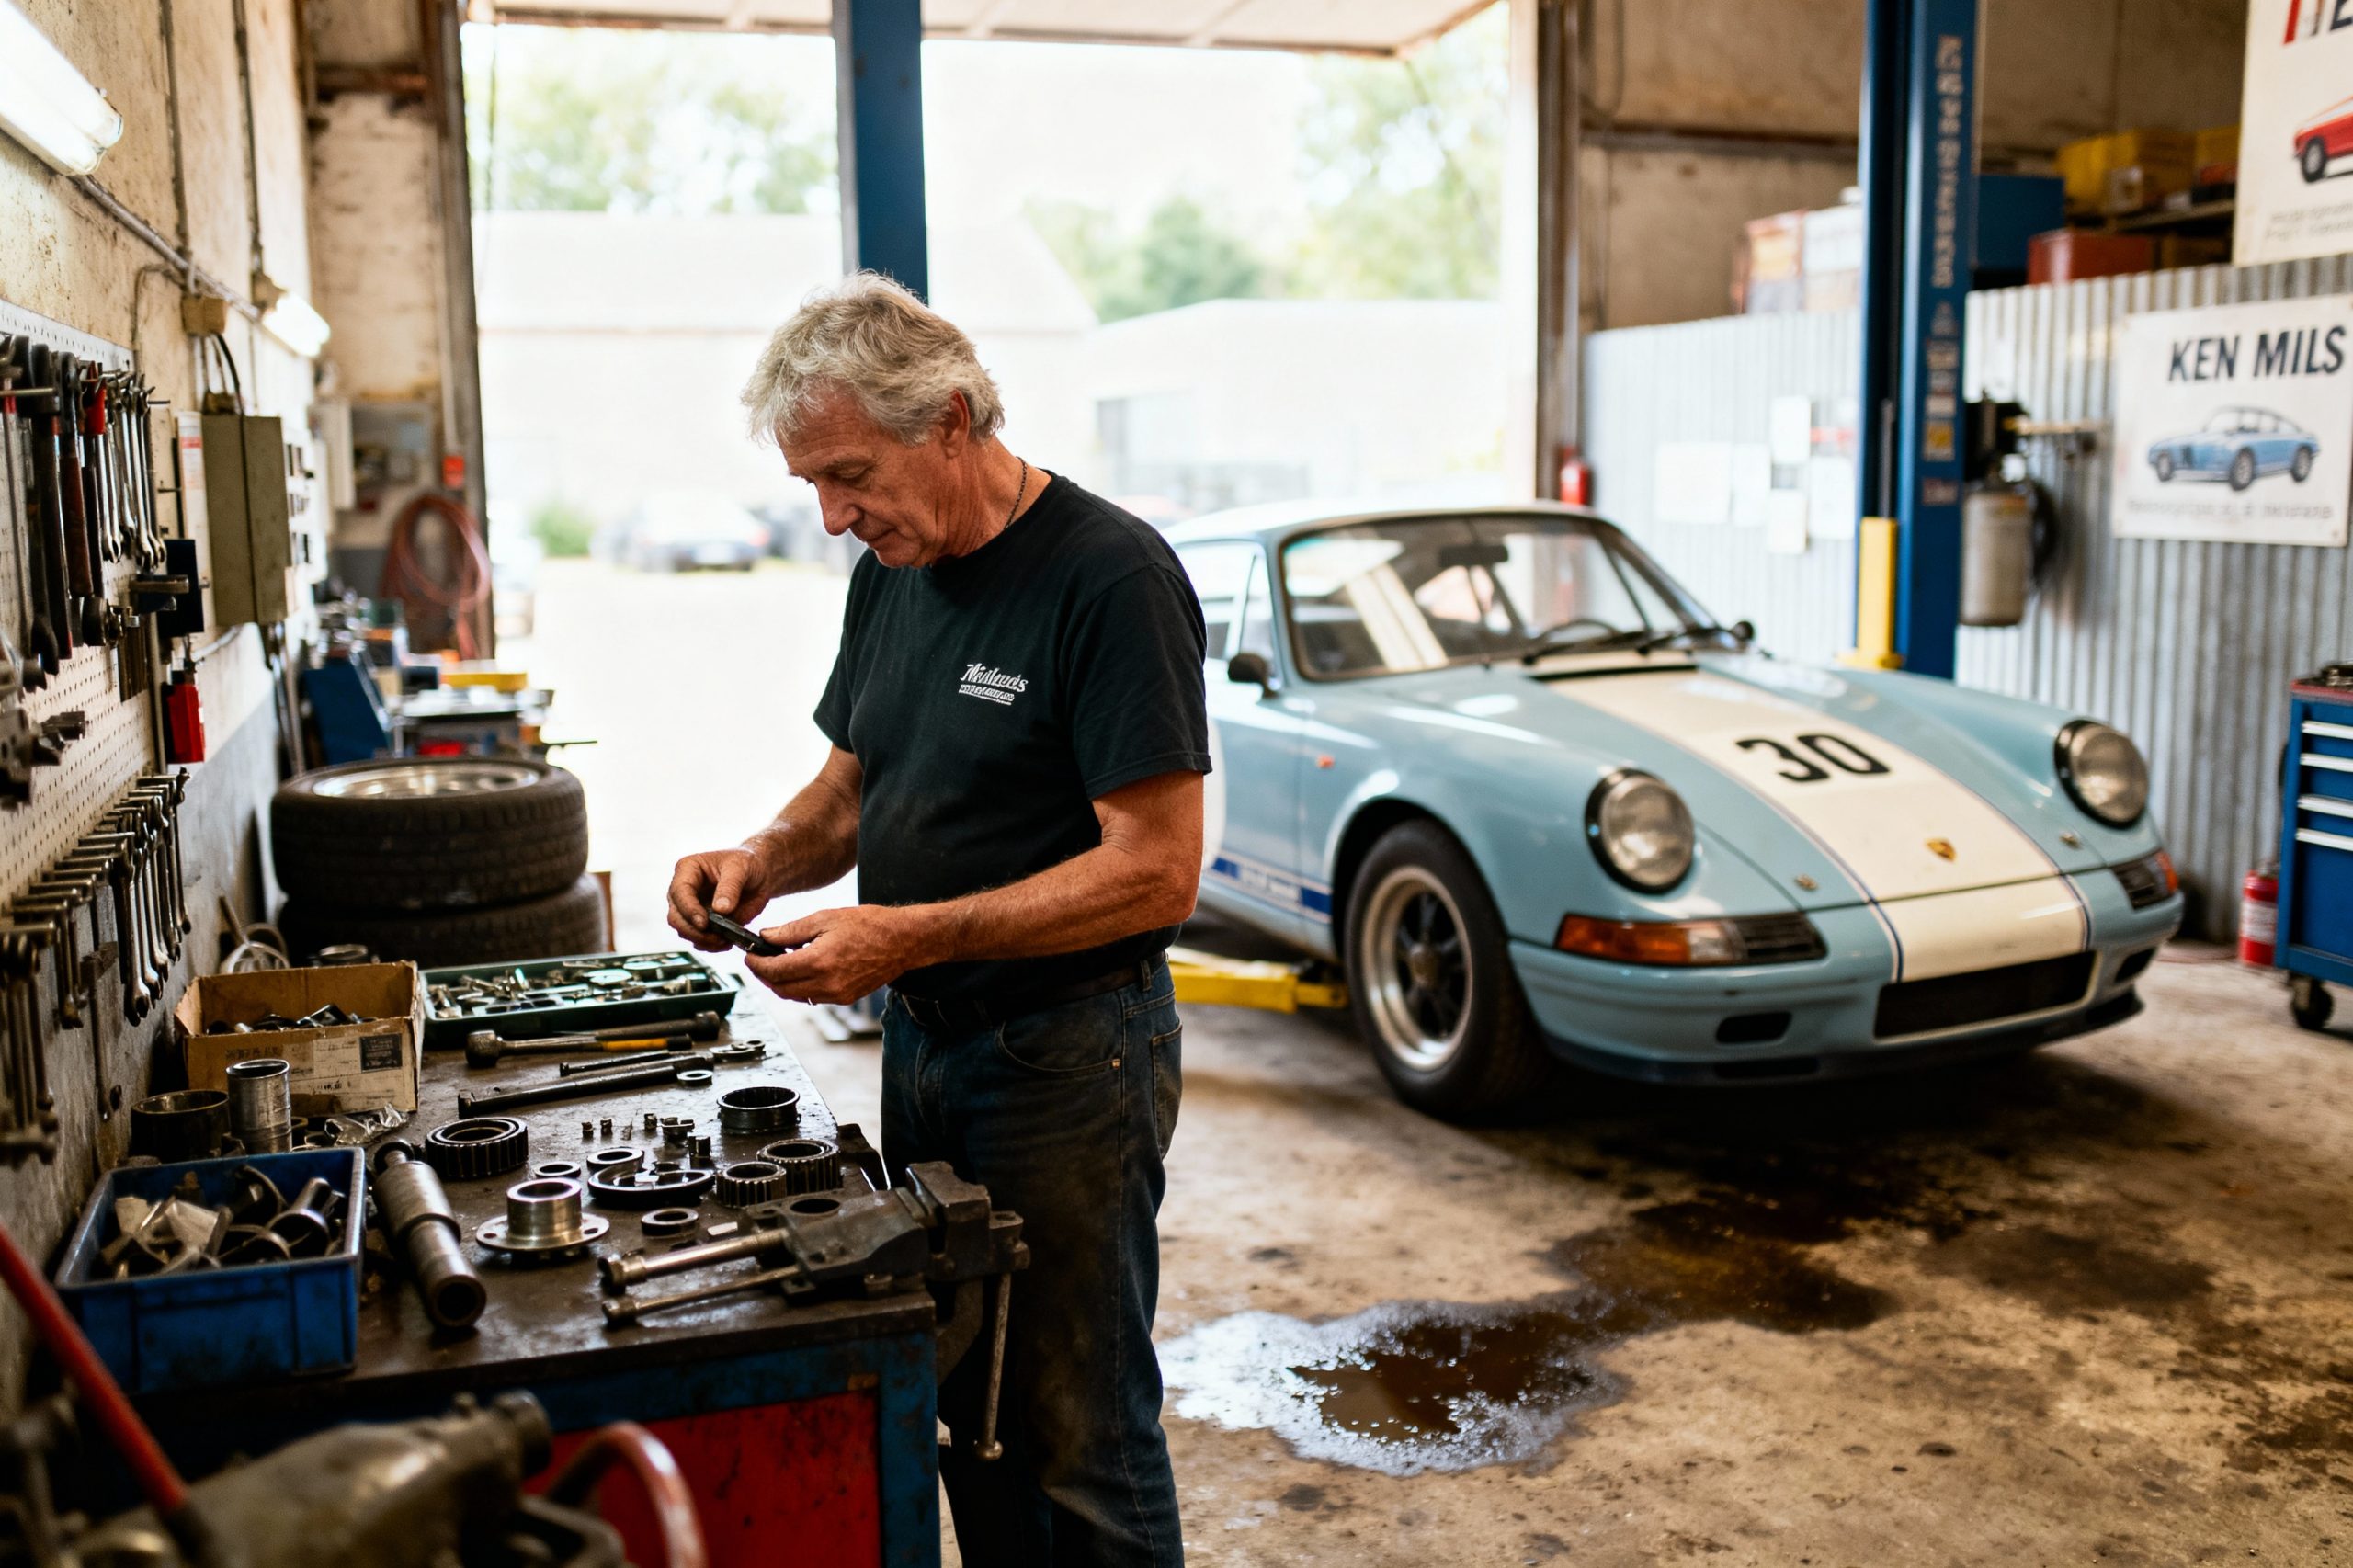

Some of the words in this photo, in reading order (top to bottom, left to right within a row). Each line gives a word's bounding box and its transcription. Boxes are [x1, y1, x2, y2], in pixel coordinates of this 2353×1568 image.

[2168, 335, 2240, 381] KEN
[2253, 325, 2347, 378] MILS
[1734, 734, 1891, 782] 30
